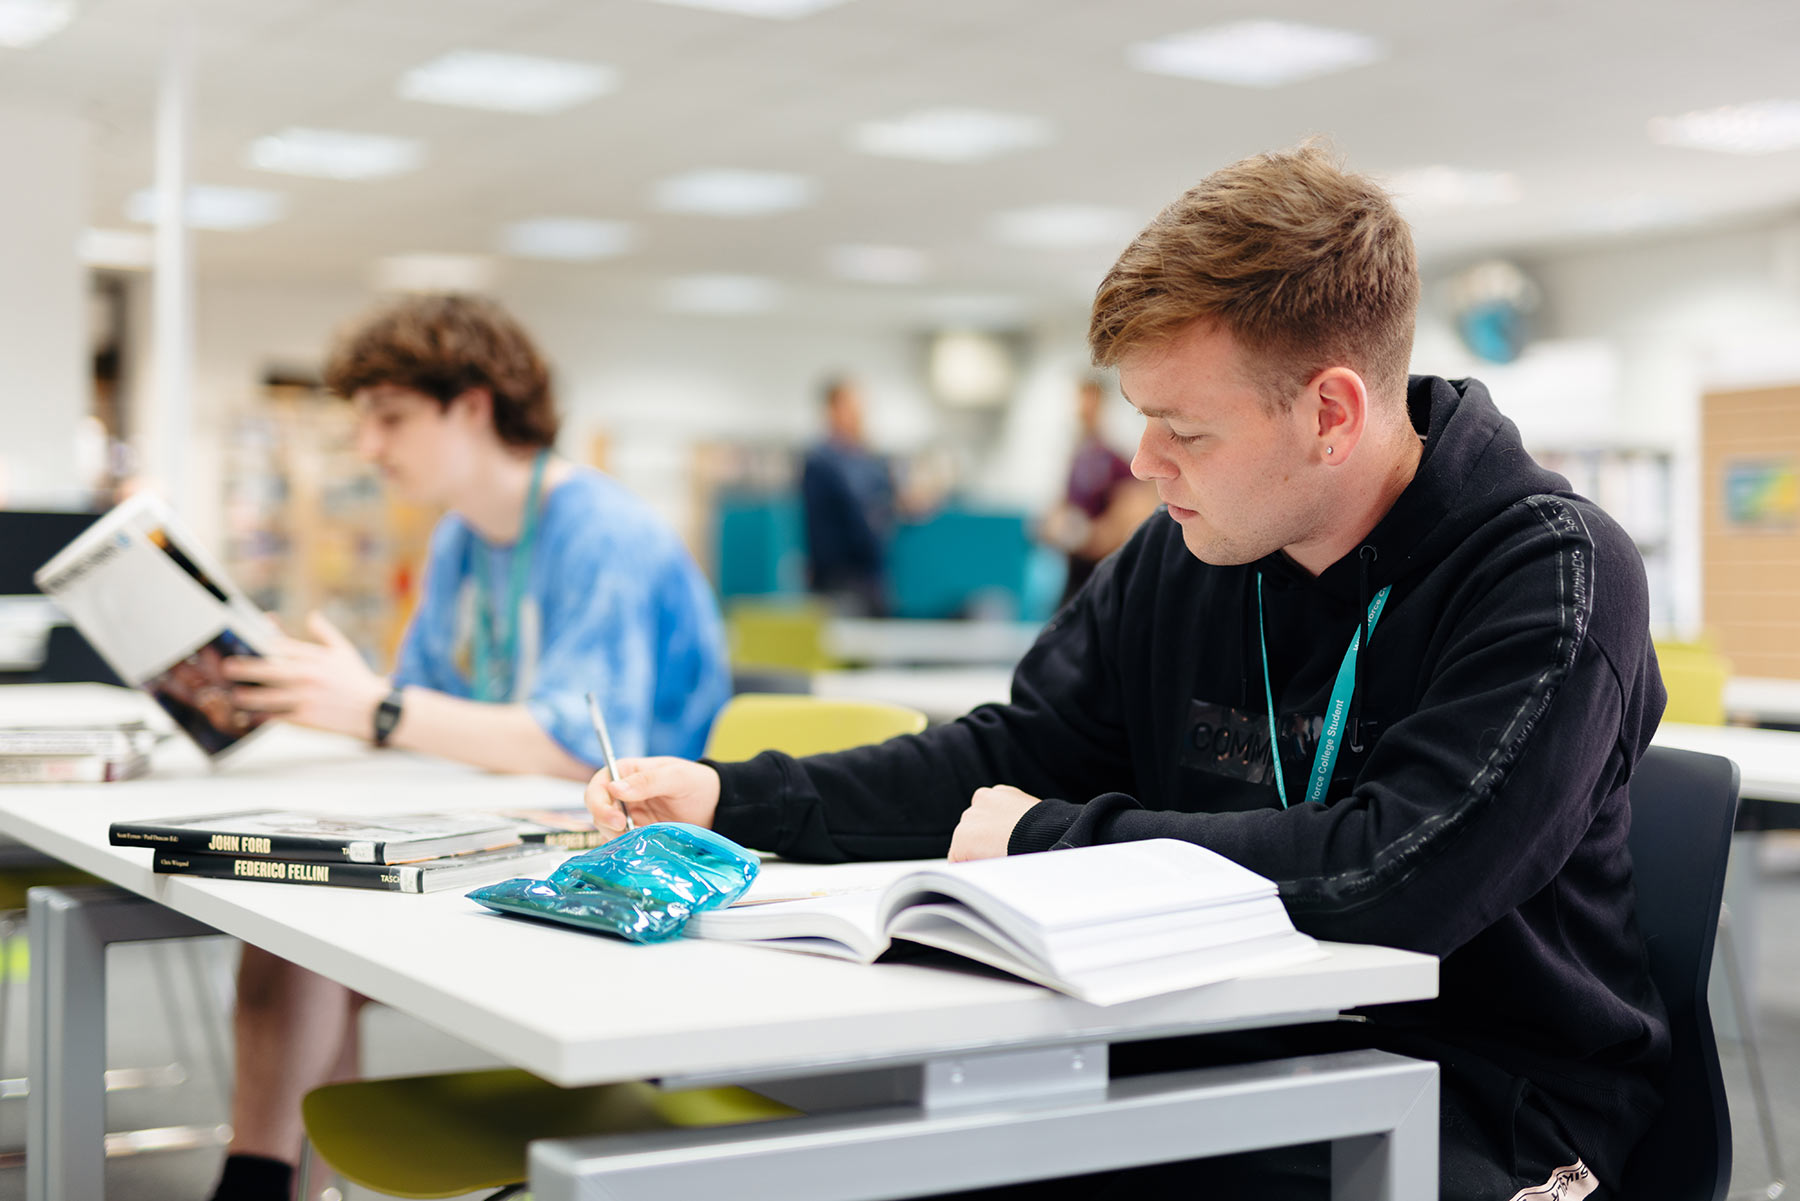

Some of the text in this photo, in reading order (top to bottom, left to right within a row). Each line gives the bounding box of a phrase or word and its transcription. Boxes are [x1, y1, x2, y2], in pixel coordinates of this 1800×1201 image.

[1317, 738, 1335, 774] College
[1326, 699, 1345, 737] Student
[208, 834, 272, 854] JOHN FORD
[234, 859, 330, 882] FEDERICO FELLINI
